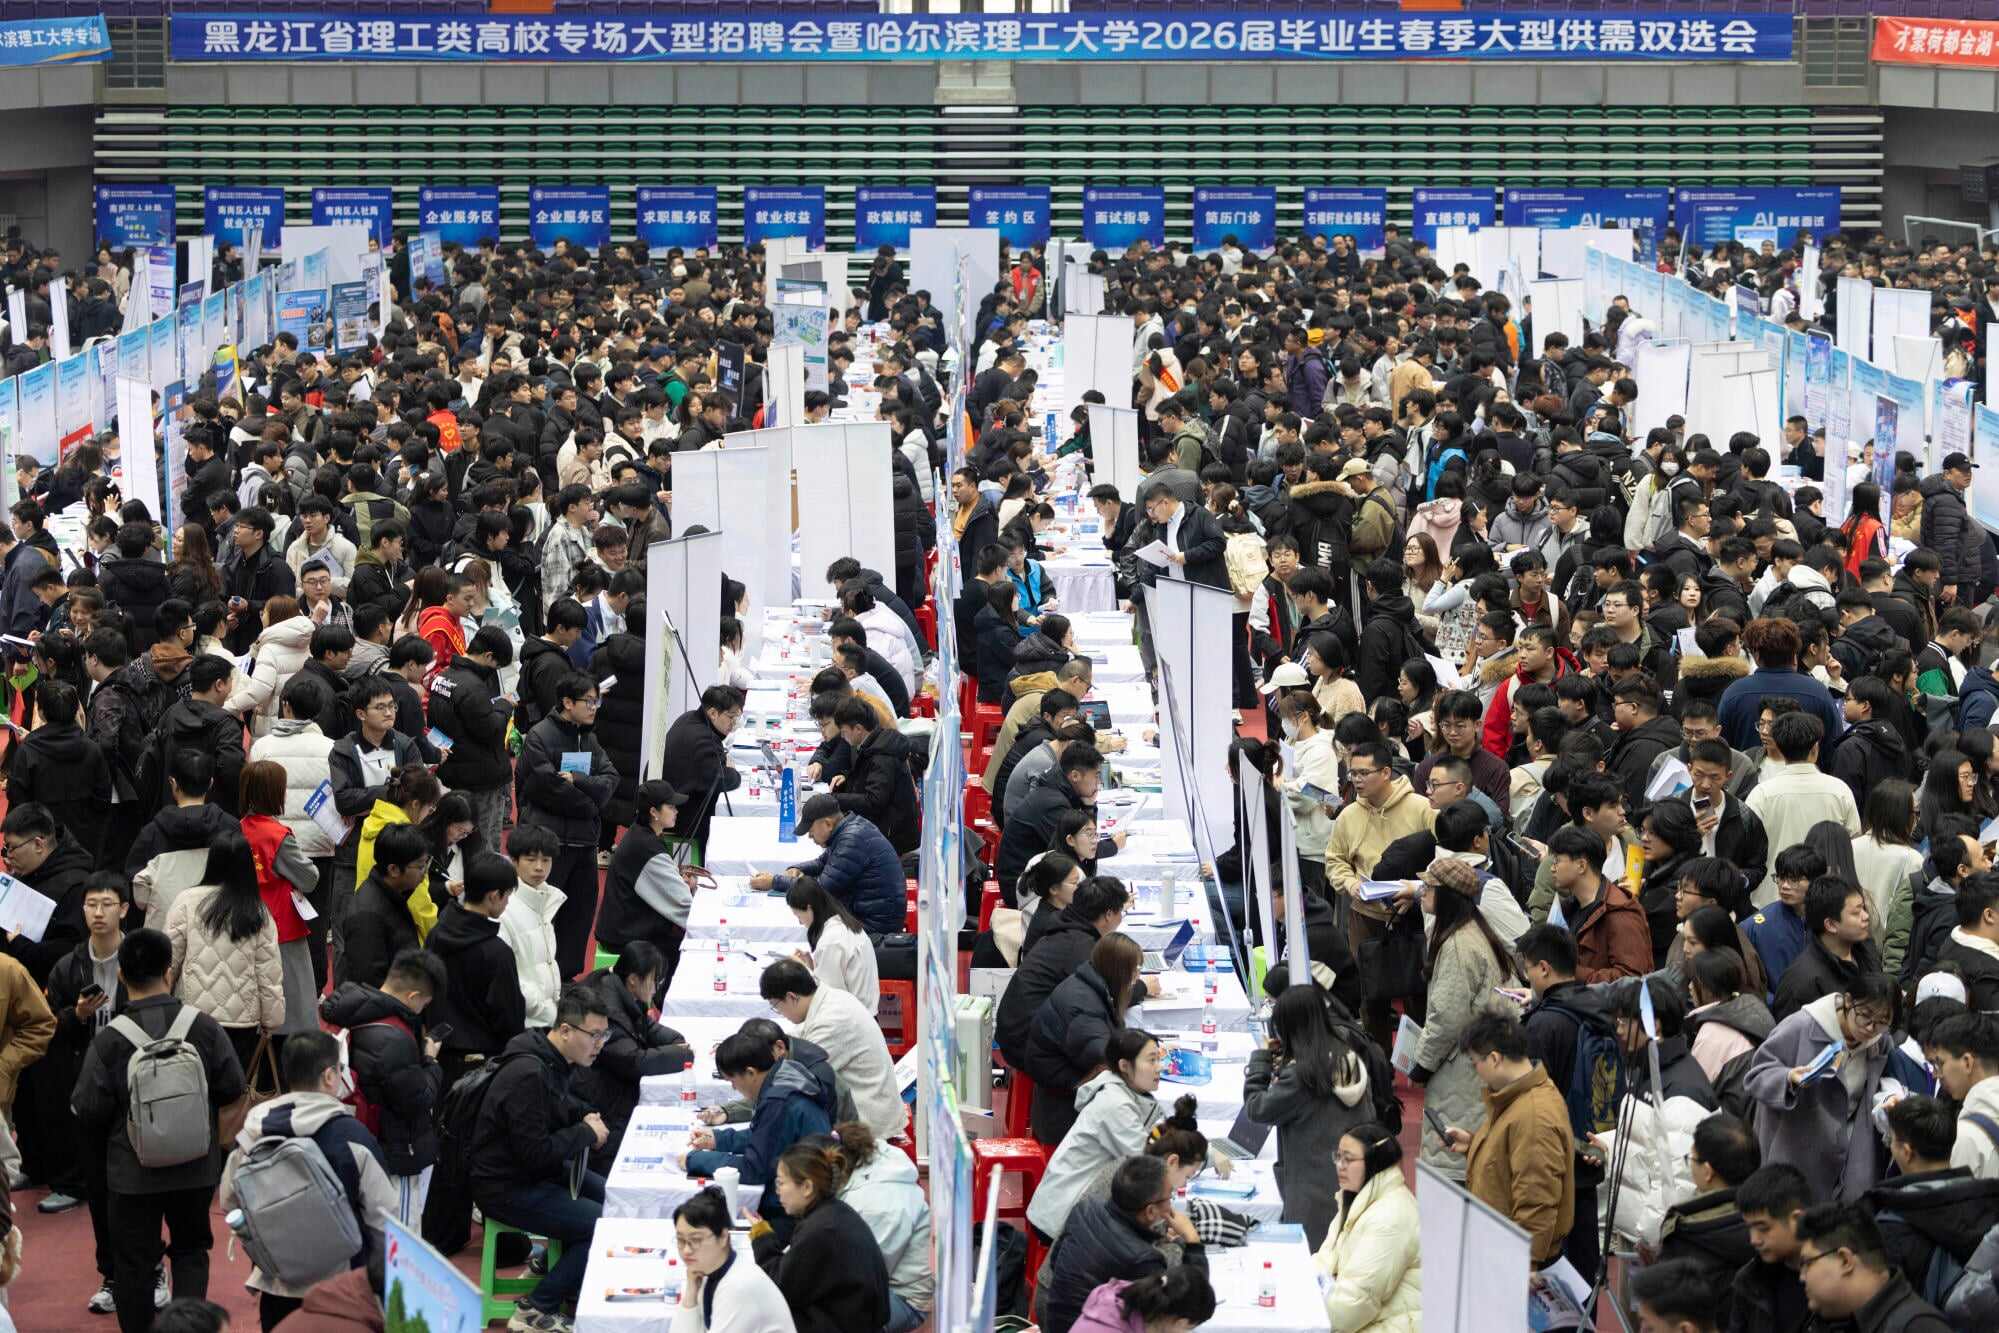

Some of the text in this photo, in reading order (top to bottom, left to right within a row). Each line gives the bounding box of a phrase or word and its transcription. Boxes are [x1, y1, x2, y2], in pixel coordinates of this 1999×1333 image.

[0, 27, 101, 48] 滨理工大学专场
[204, 18, 1757, 55] 黑龙江省理工类高校专场大型招聘会暨哈尔滨理工大学2026届毕业生春季大型供需双选会
[1894, 25, 1999, 57] 才聚荷都金湖
[425, 210, 494, 224] 企业服务区
[536, 210, 604, 224] 企业服务区
[643, 210, 711, 224] 求职服务区
[755, 210, 811, 224] 就业权益
[867, 210, 922, 224] 政策解读
[986, 210, 1036, 224] 签约区
[1095, 210, 1151, 225] 面试指导
[1205, 210, 1262, 225] 简历门诊
